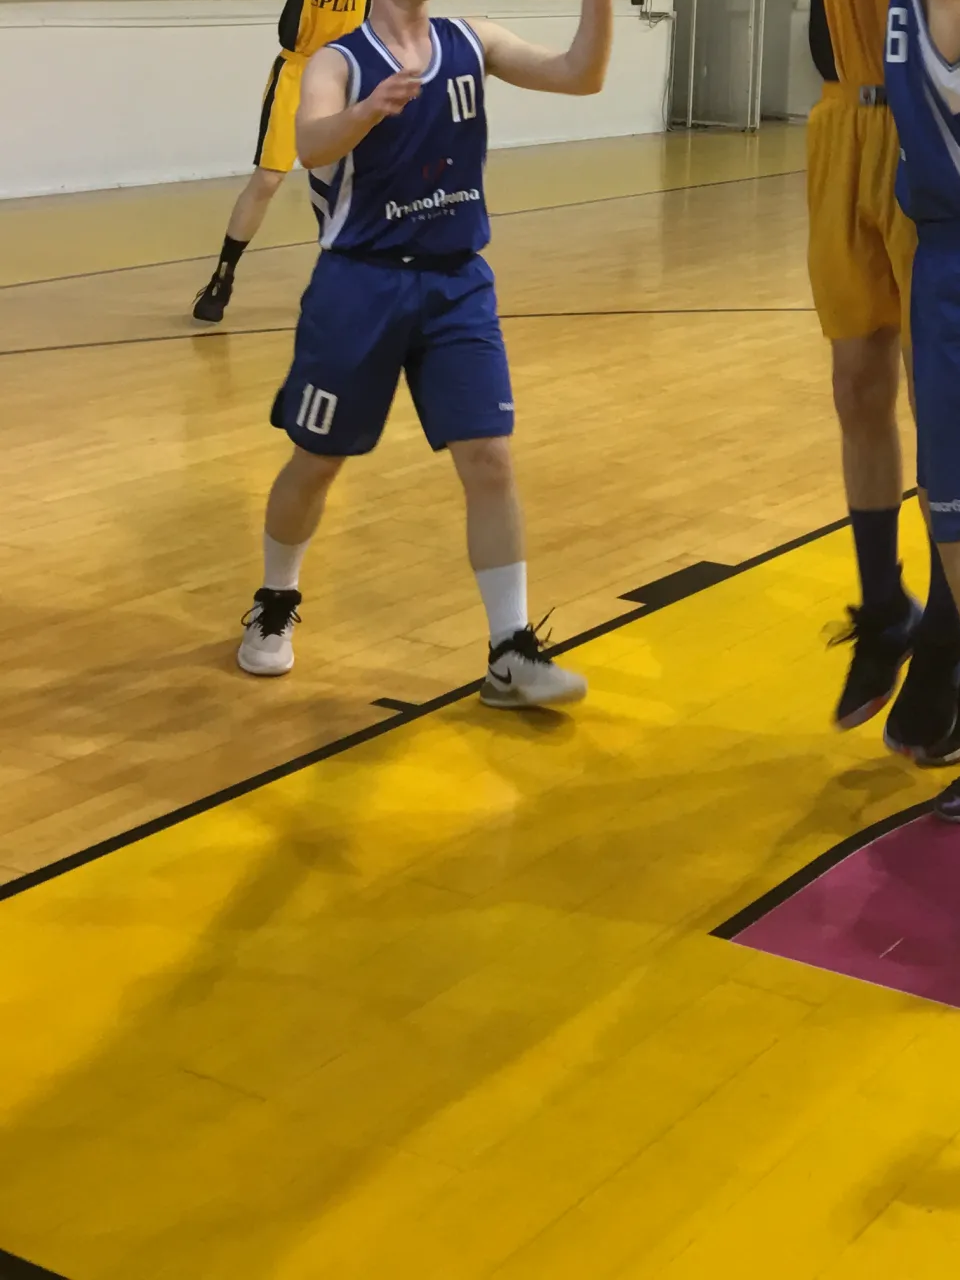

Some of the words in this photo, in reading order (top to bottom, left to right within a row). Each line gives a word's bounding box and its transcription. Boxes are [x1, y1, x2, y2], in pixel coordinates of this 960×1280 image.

[886, 7, 908, 63] 6
[446, 73, 477, 123] 10
[296, 382, 339, 436] 10
